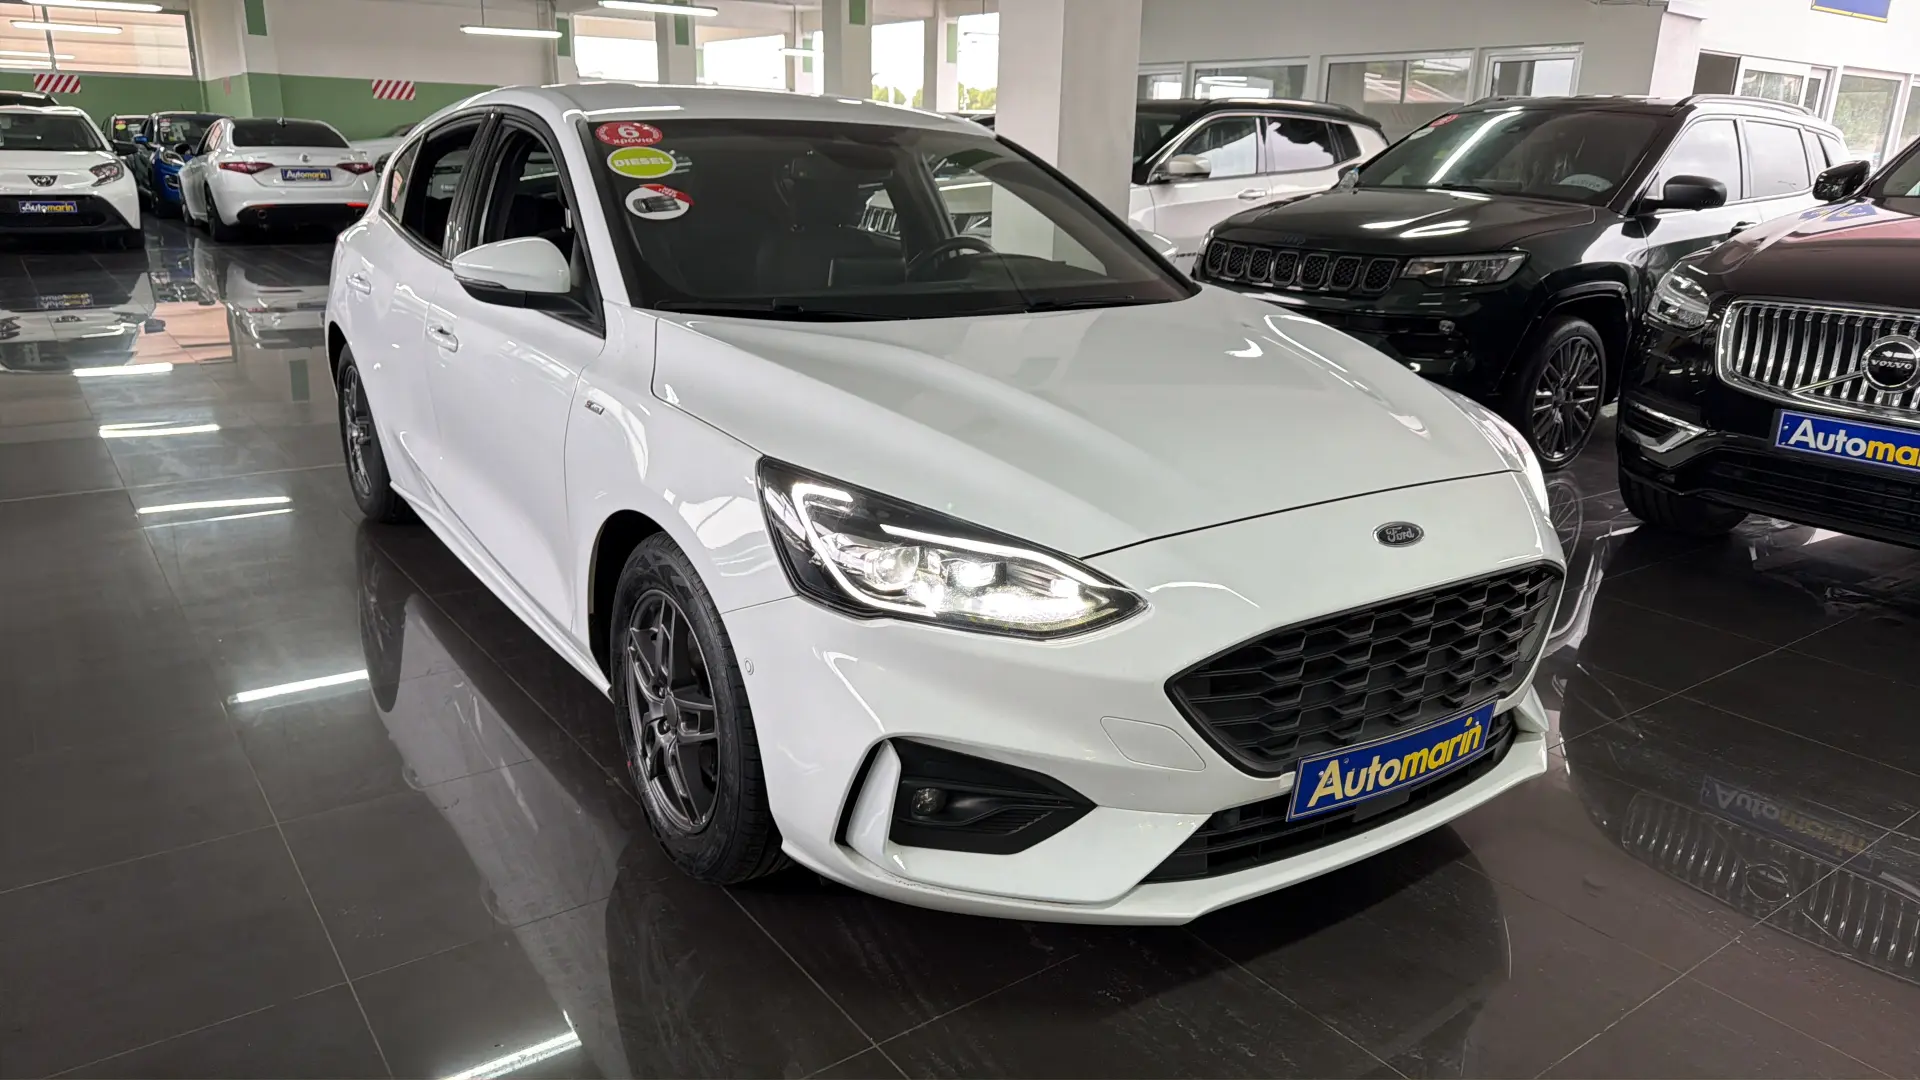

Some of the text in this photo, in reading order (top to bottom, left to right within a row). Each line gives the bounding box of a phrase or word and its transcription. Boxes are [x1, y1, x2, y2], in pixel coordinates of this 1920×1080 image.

[617, 125, 640, 138] 6
[614, 157, 671, 167] DIESEL
[286, 169, 327, 179] Automarin
[21, 202, 75, 213] Automarin
[1871, 359, 1913, 370] VOLVO
[1788, 418, 1920, 468] Automa
[1385, 526, 1415, 543] Ford
[1306, 716, 1482, 808] Automarin
